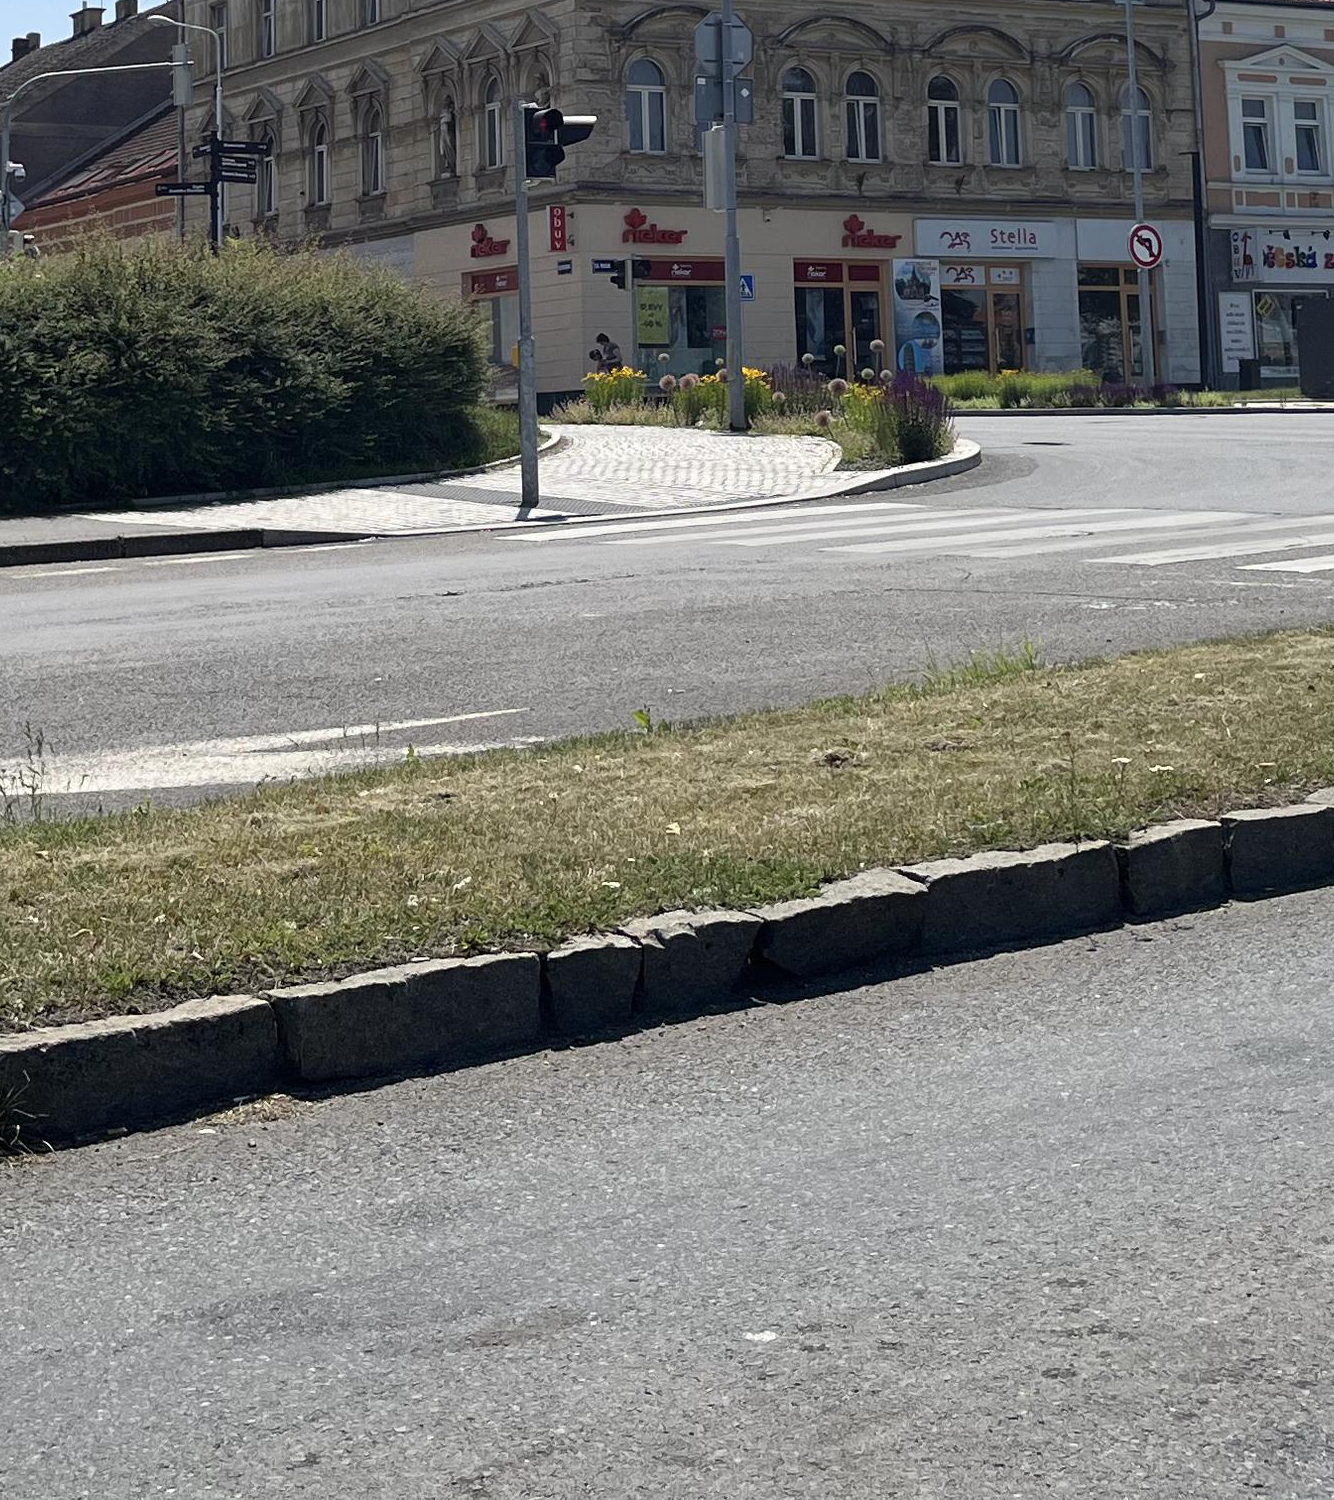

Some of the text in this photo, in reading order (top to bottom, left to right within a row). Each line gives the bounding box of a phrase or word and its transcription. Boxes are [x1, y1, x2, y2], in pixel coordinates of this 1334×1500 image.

[553, 208, 562, 249] obuv
[622, 220, 688, 244] rieker
[842, 225, 902, 248] rieker
[990, 228, 1037, 245] Stella
[1263, 245, 1317, 269] ětská
